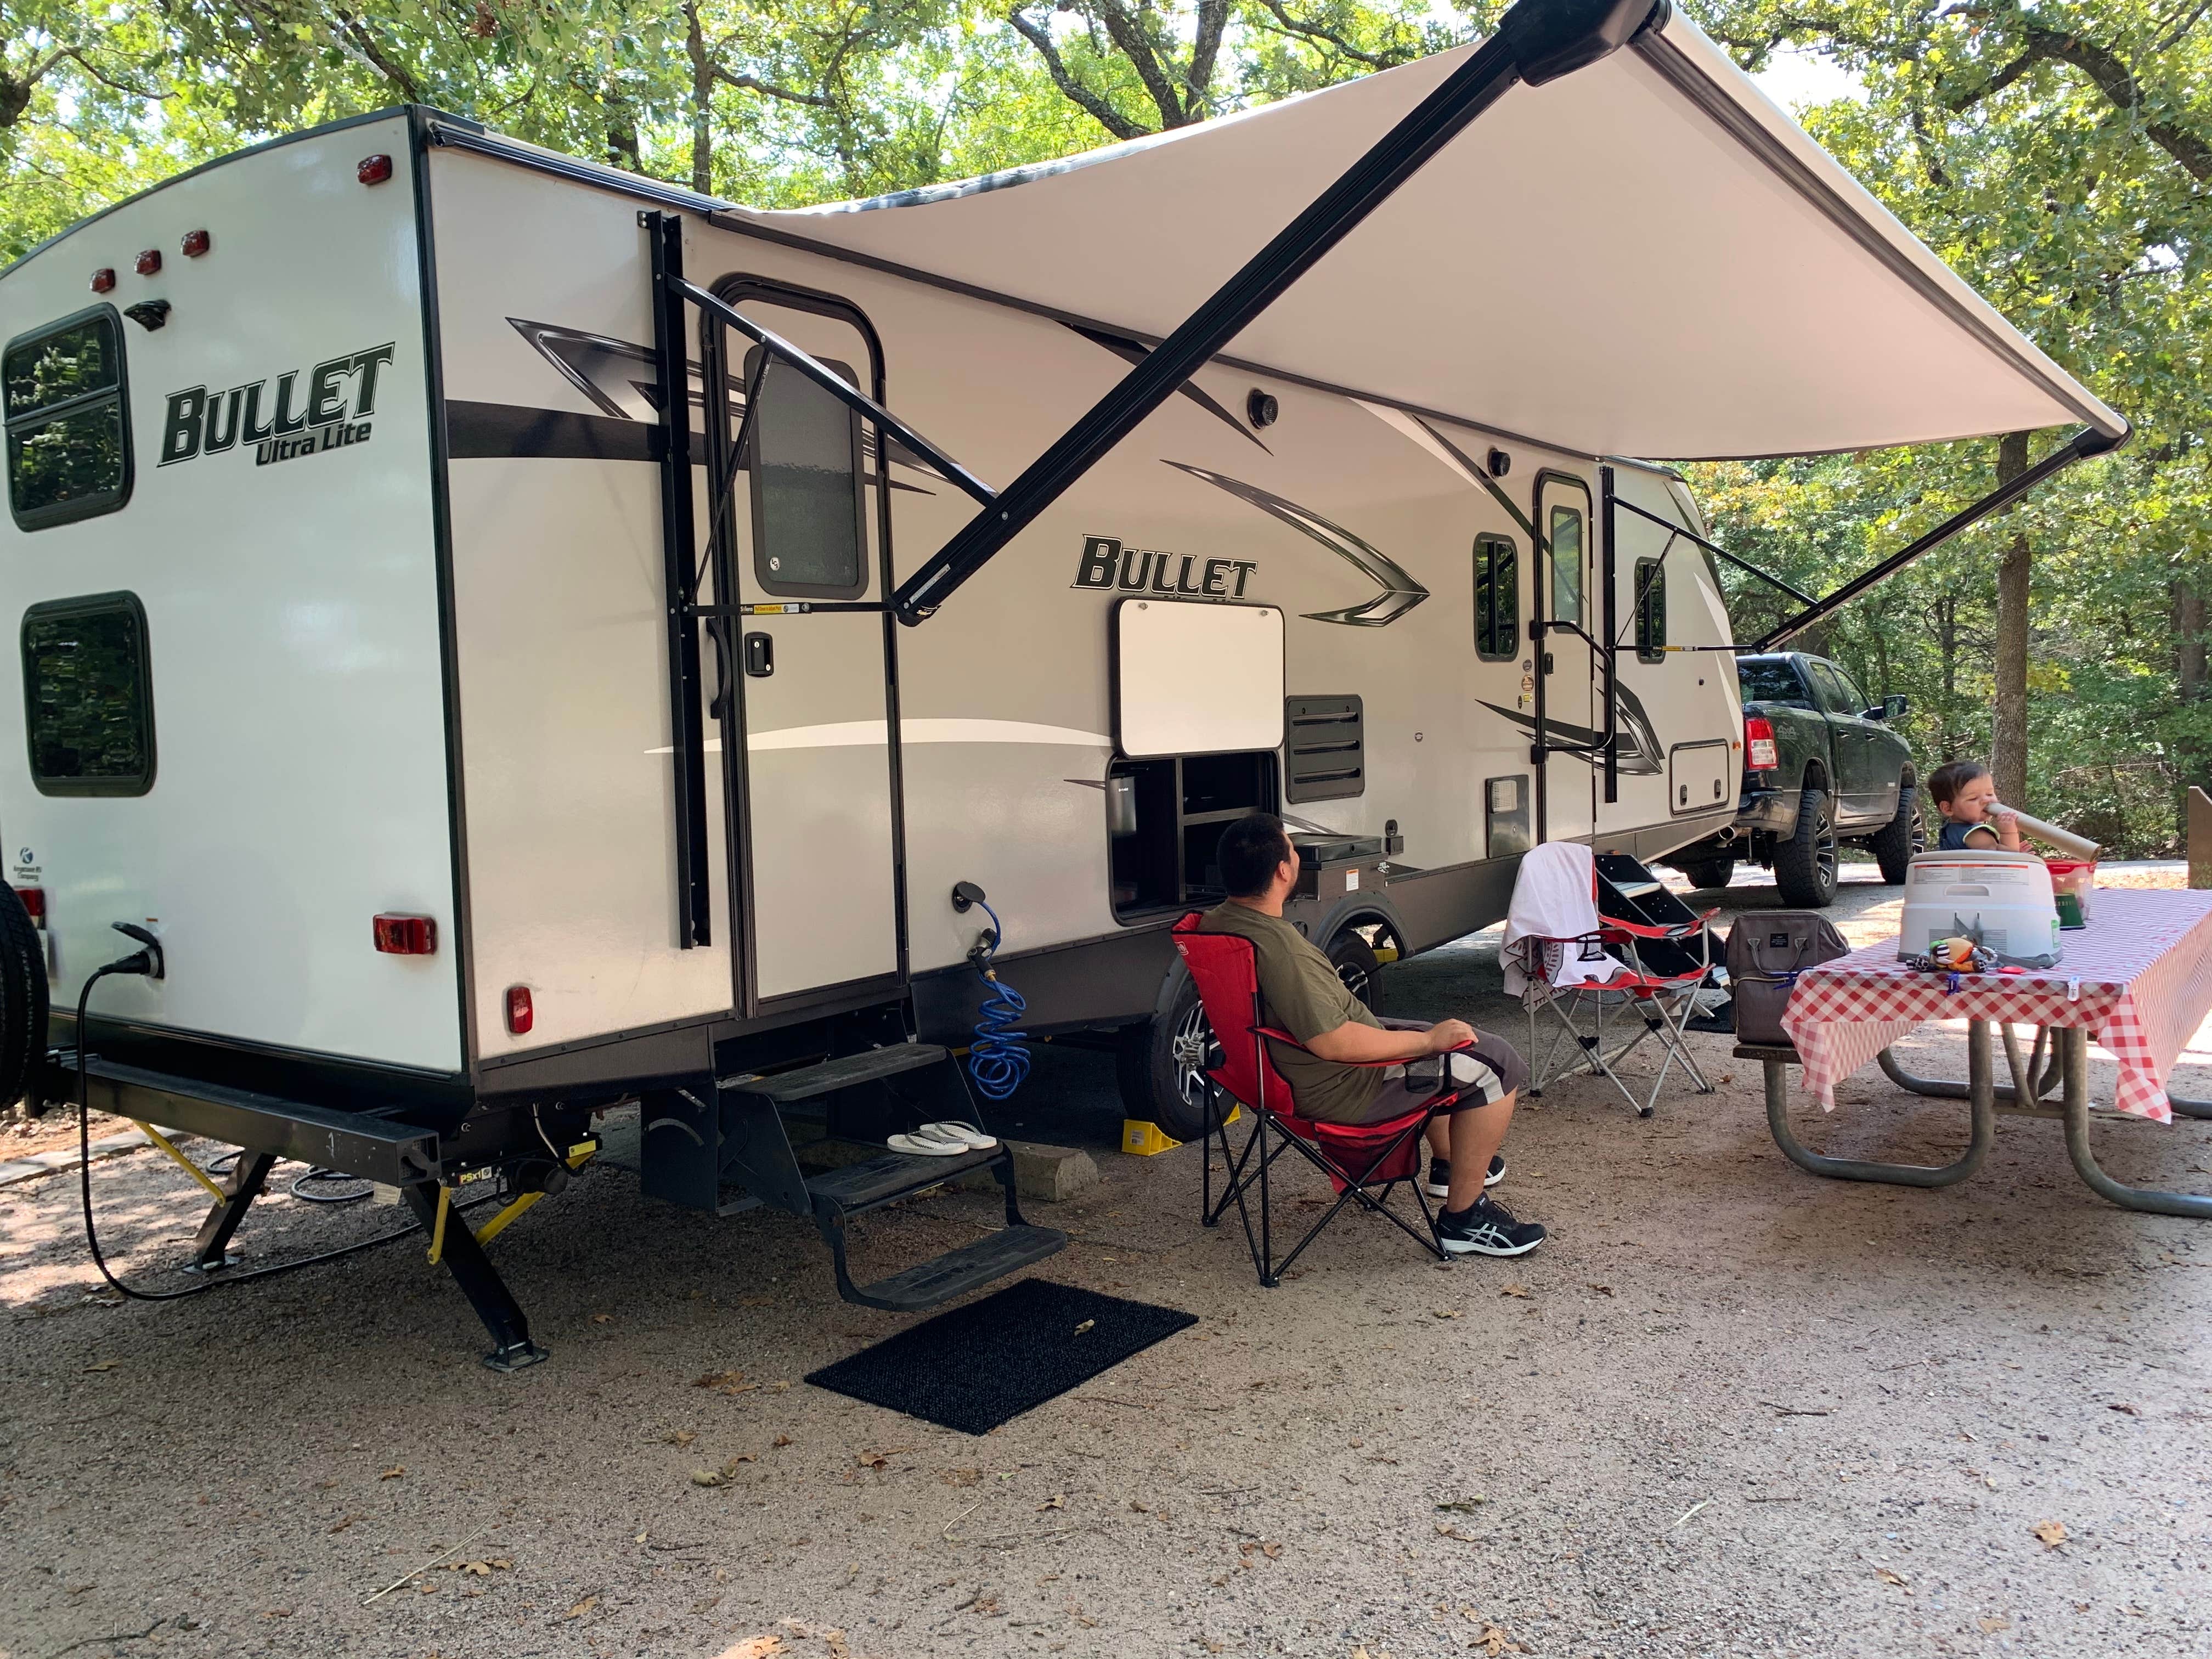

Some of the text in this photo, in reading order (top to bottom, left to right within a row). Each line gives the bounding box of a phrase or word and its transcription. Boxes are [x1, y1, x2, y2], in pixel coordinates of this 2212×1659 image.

[156, 341, 396, 467] BULLET
[256, 422, 371, 465] Ultra Lite
[1070, 534, 1258, 599] BULLET
